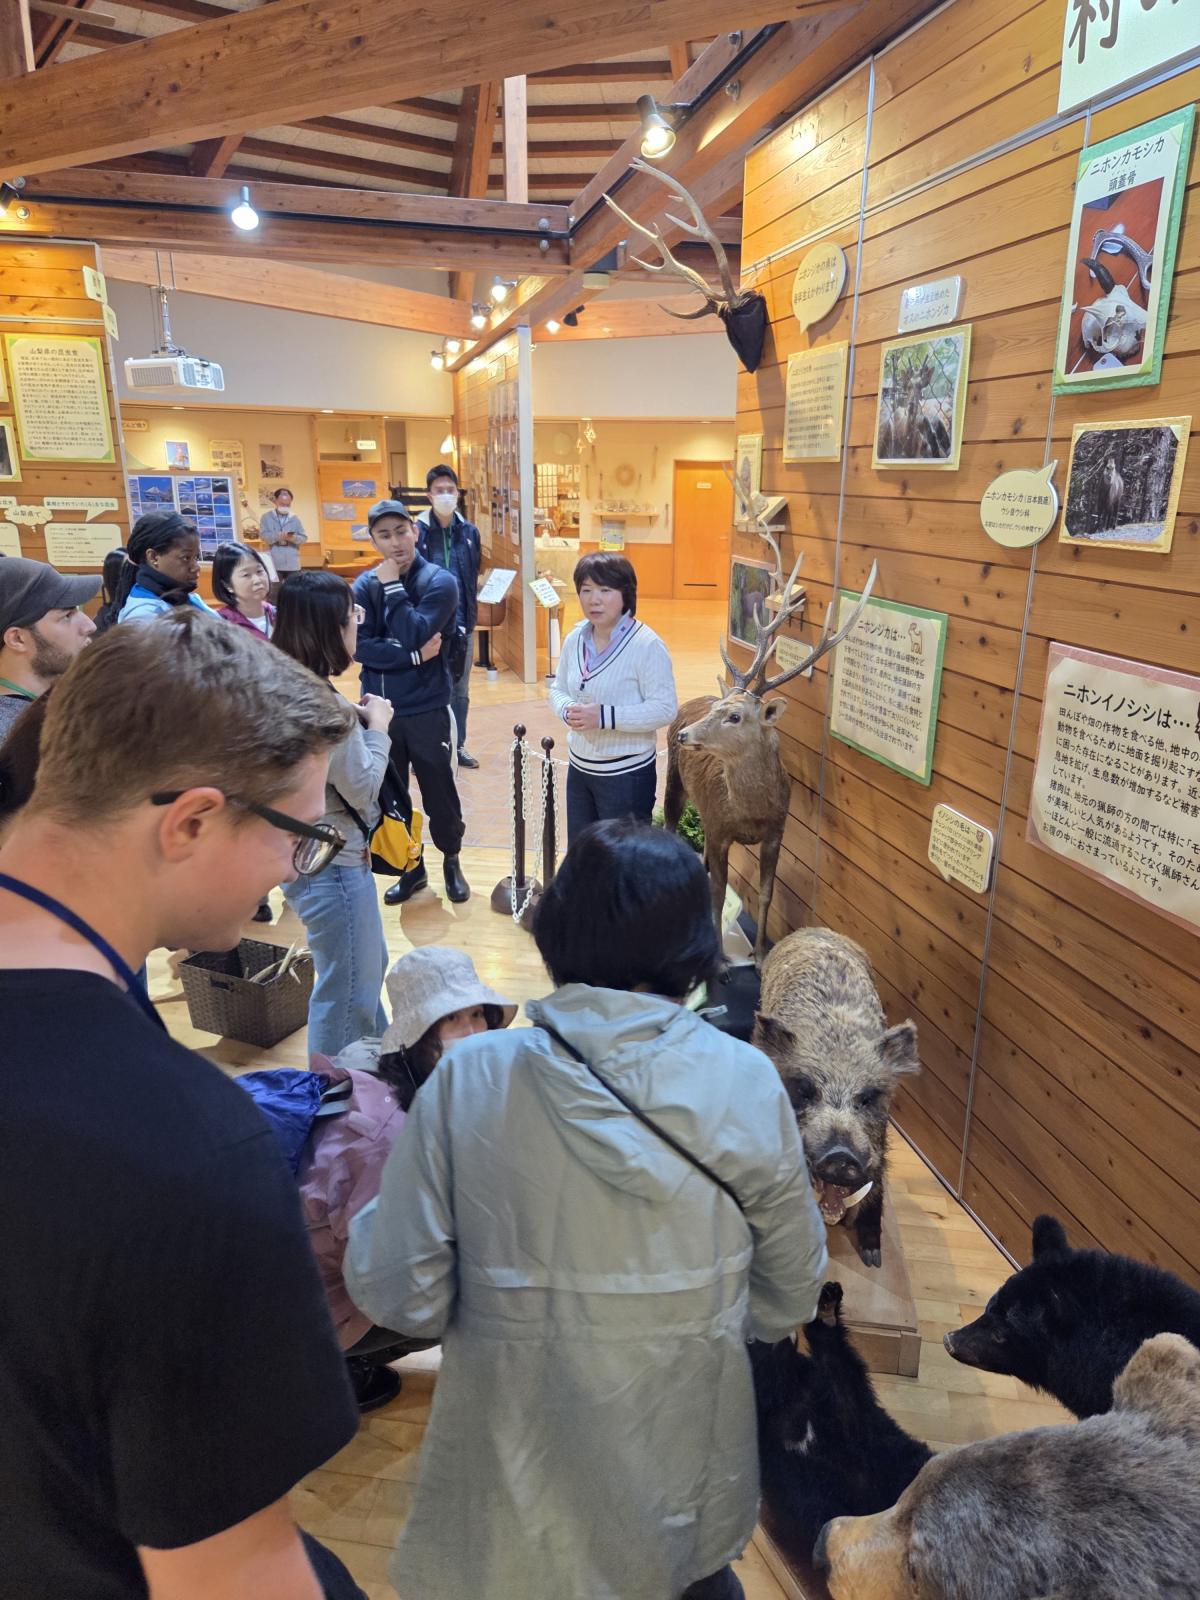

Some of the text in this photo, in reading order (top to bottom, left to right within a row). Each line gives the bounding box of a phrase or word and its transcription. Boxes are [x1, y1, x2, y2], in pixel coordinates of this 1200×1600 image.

[1091, 136, 1165, 176] ニホンカモシカ
[1108, 171, 1137, 192] 頭蓋骨
[1059, 707, 1200, 762] 田んぼや畑の作物を食べる他、地中の
[1052, 765, 1086, 790] しています。
[1056, 736, 1200, 800] に困った存在になることがあります。近
